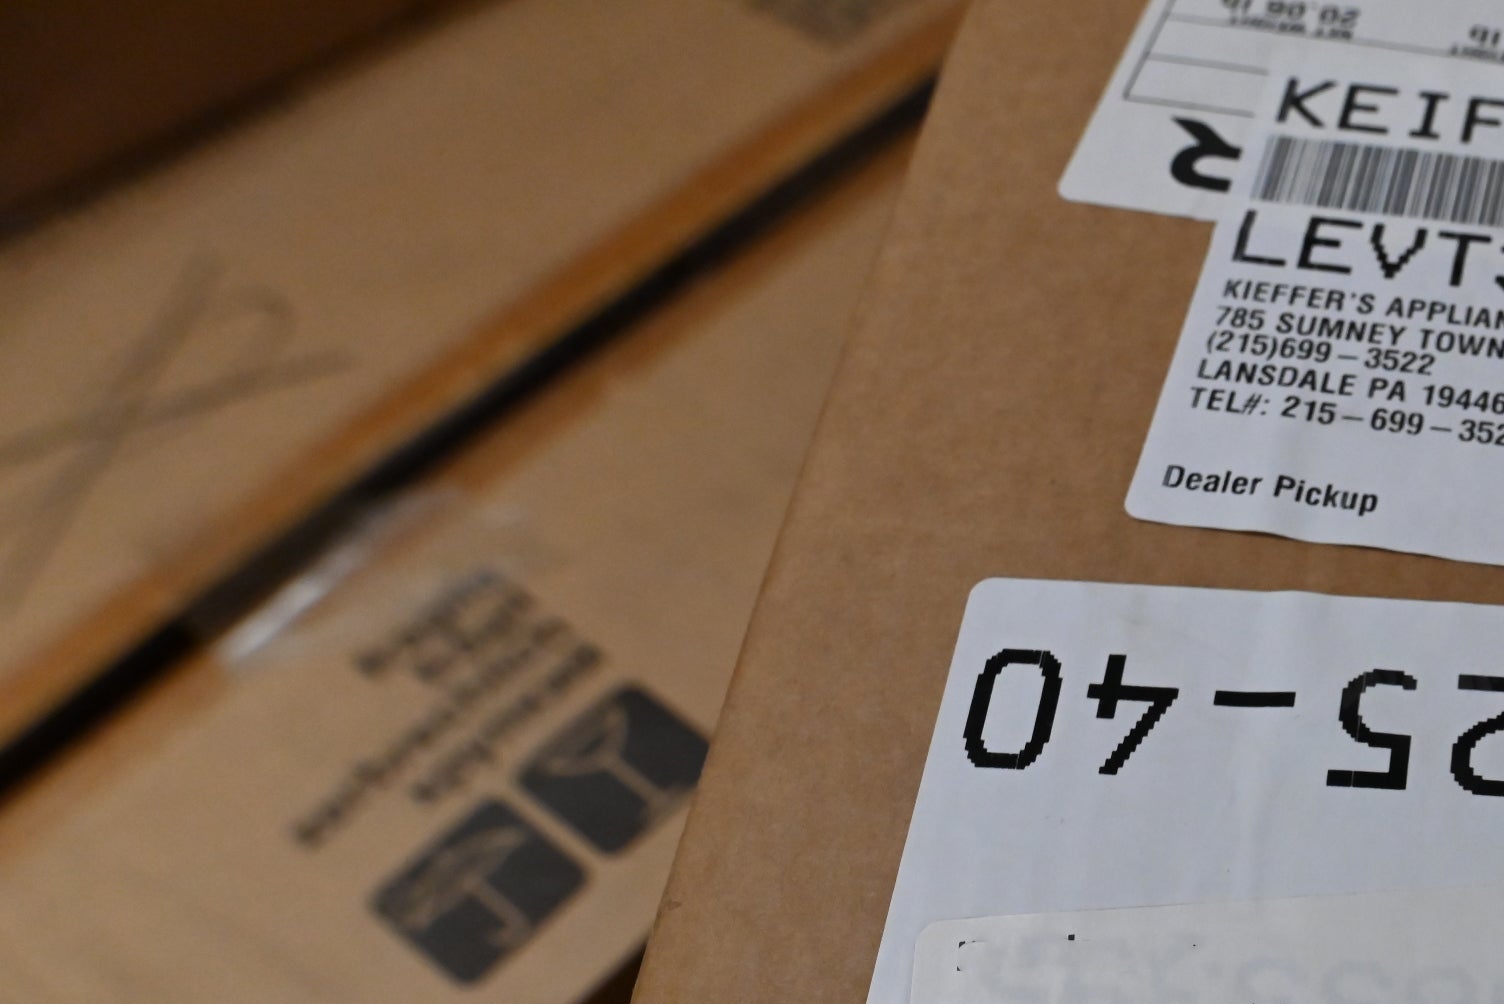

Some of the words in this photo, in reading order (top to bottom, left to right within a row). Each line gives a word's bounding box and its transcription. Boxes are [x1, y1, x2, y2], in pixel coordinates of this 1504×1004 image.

[1468, 25, 1502, 48] lb
[1222, 279, 1376, 315] KIEFFER'S
[1215, 306, 1266, 330] 785
[1276, 312, 1407, 347] SUMNEY
[1205, 330, 1436, 376] (215)699-3522
[1196, 358, 1357, 397] LANSDALE
[1368, 379, 1407, 402] PA
[1189, 387, 1268, 417] TEL#:
[1162, 464, 1262, 497] Dealer
[1273, 475, 1379, 514] Pickup
